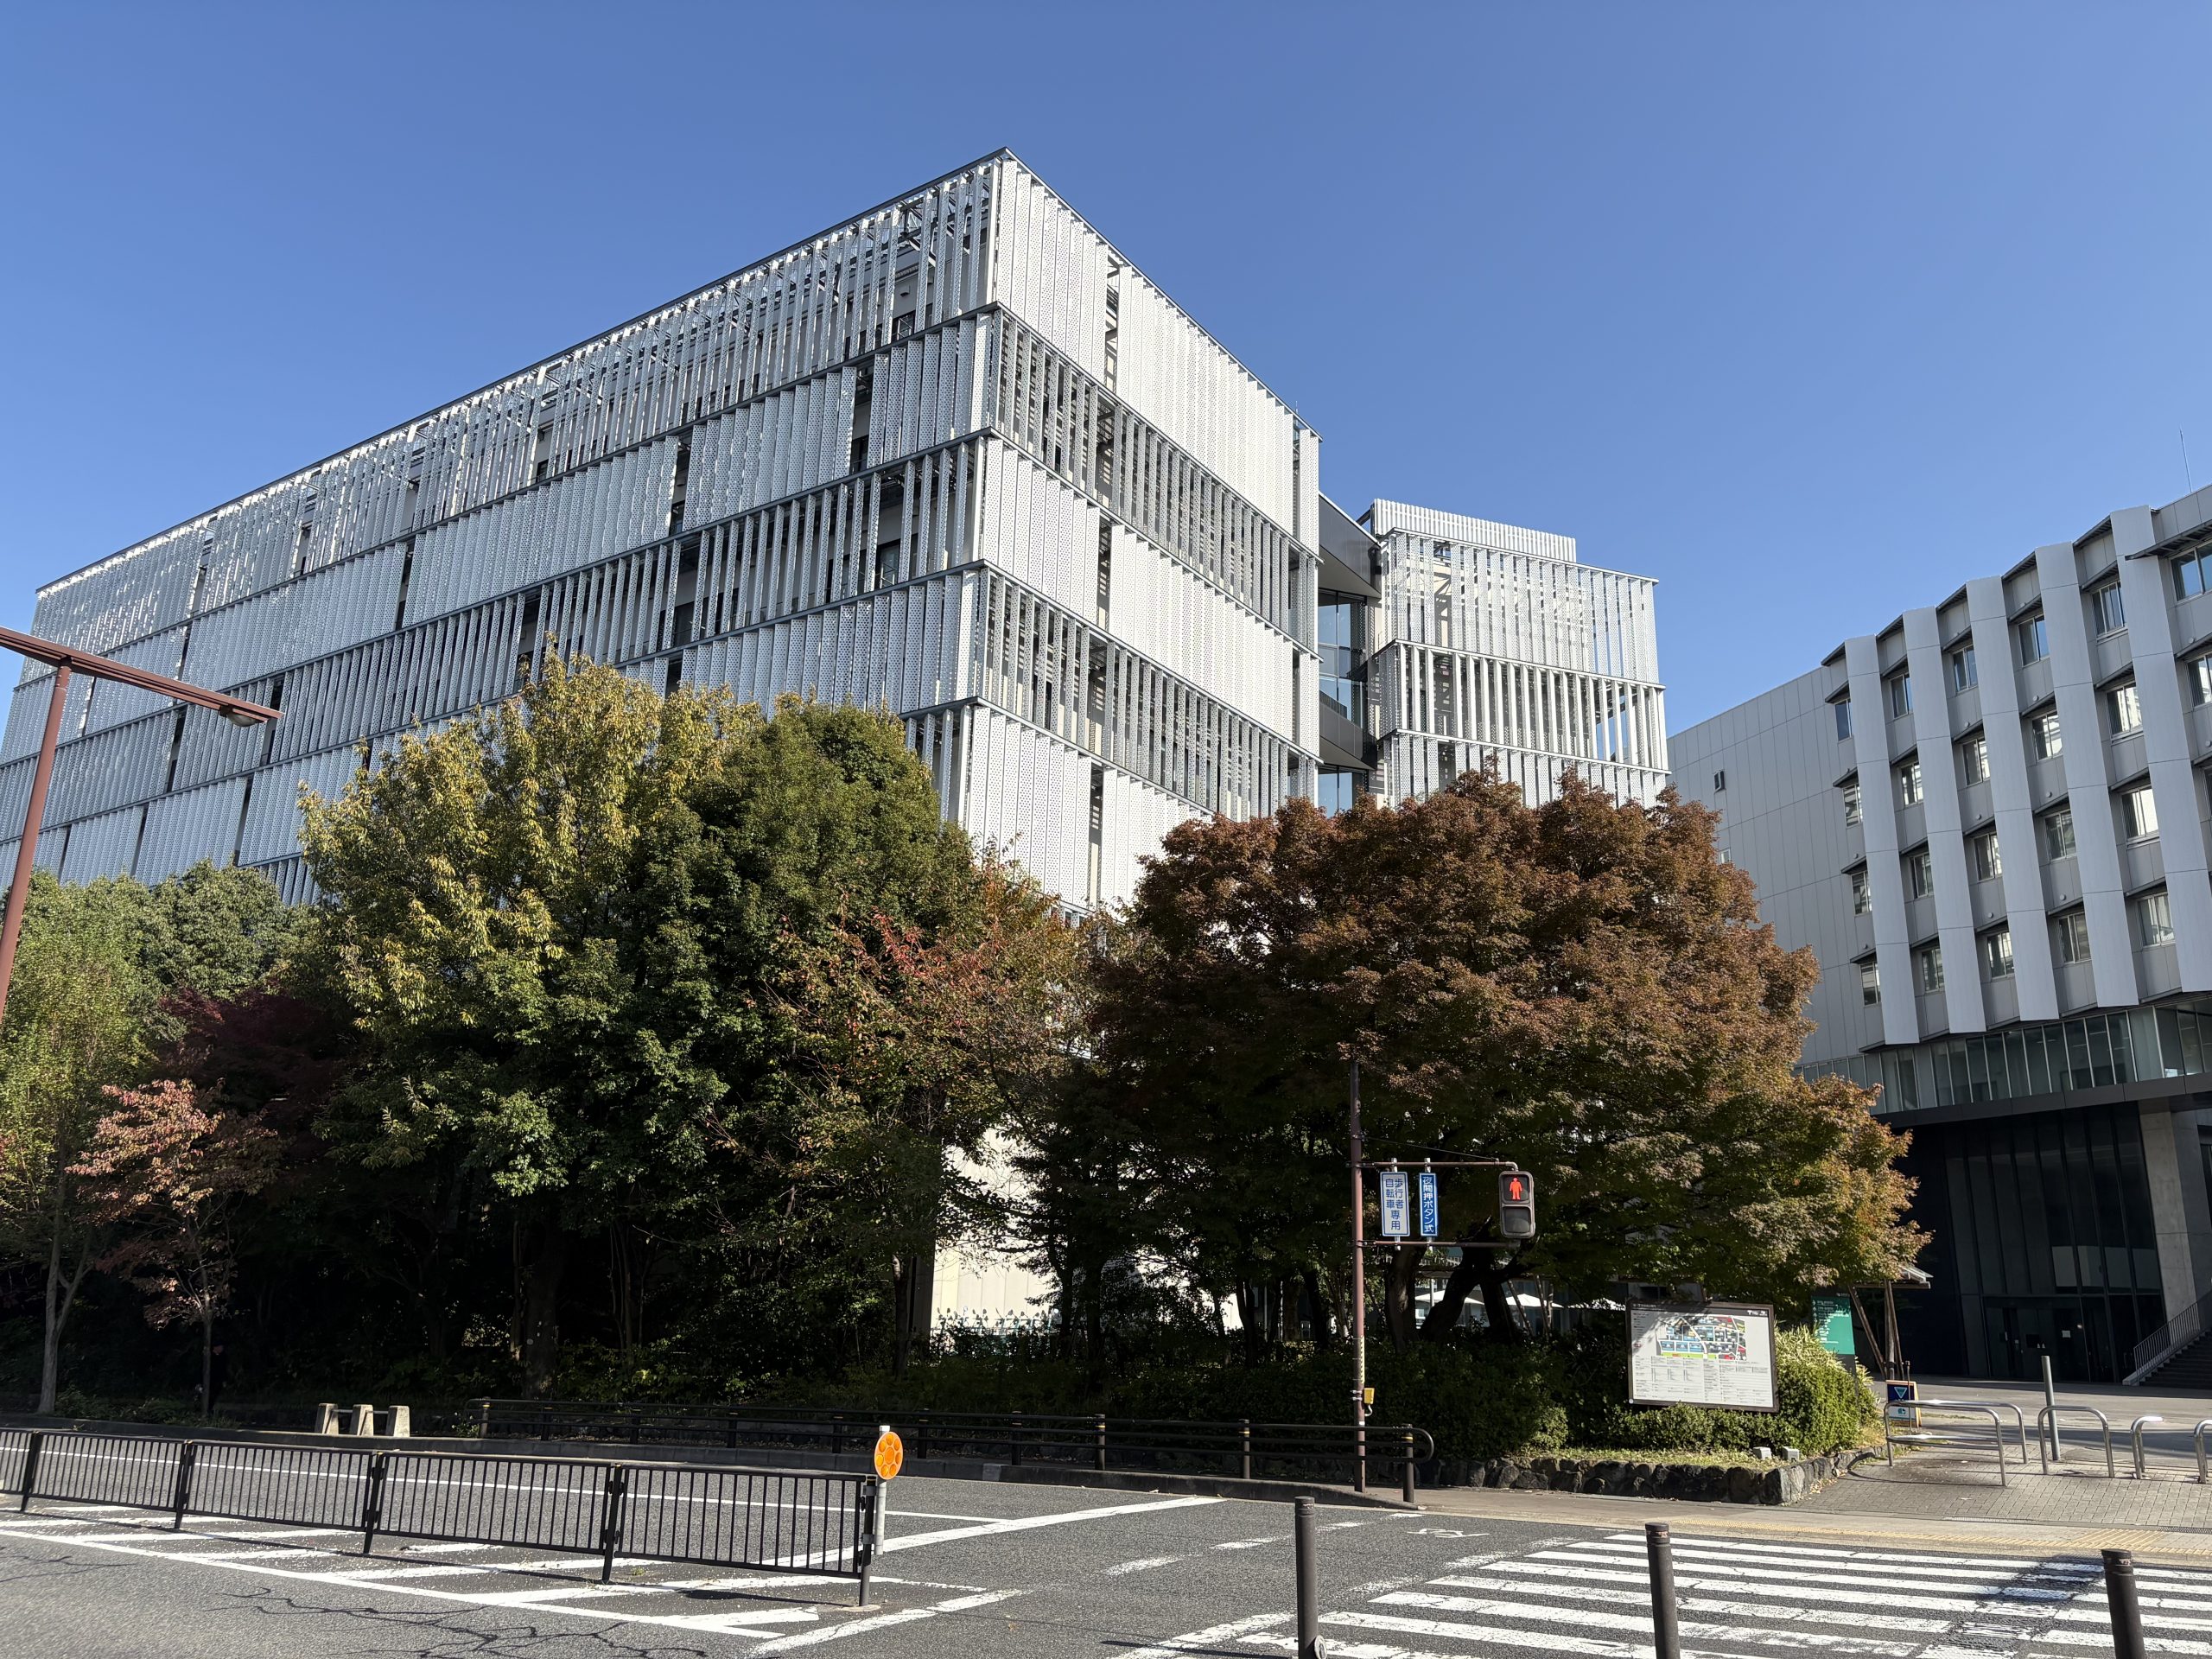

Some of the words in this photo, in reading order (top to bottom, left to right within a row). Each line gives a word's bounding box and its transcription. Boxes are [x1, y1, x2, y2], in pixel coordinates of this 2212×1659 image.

[1386, 1179, 1395, 1209] 自転車
[1395, 1178, 1404, 1209] 歩行者
[1422, 1176, 1434, 1233] 夜間押ボタン式
[1390, 1210, 1401, 1230] 専用
